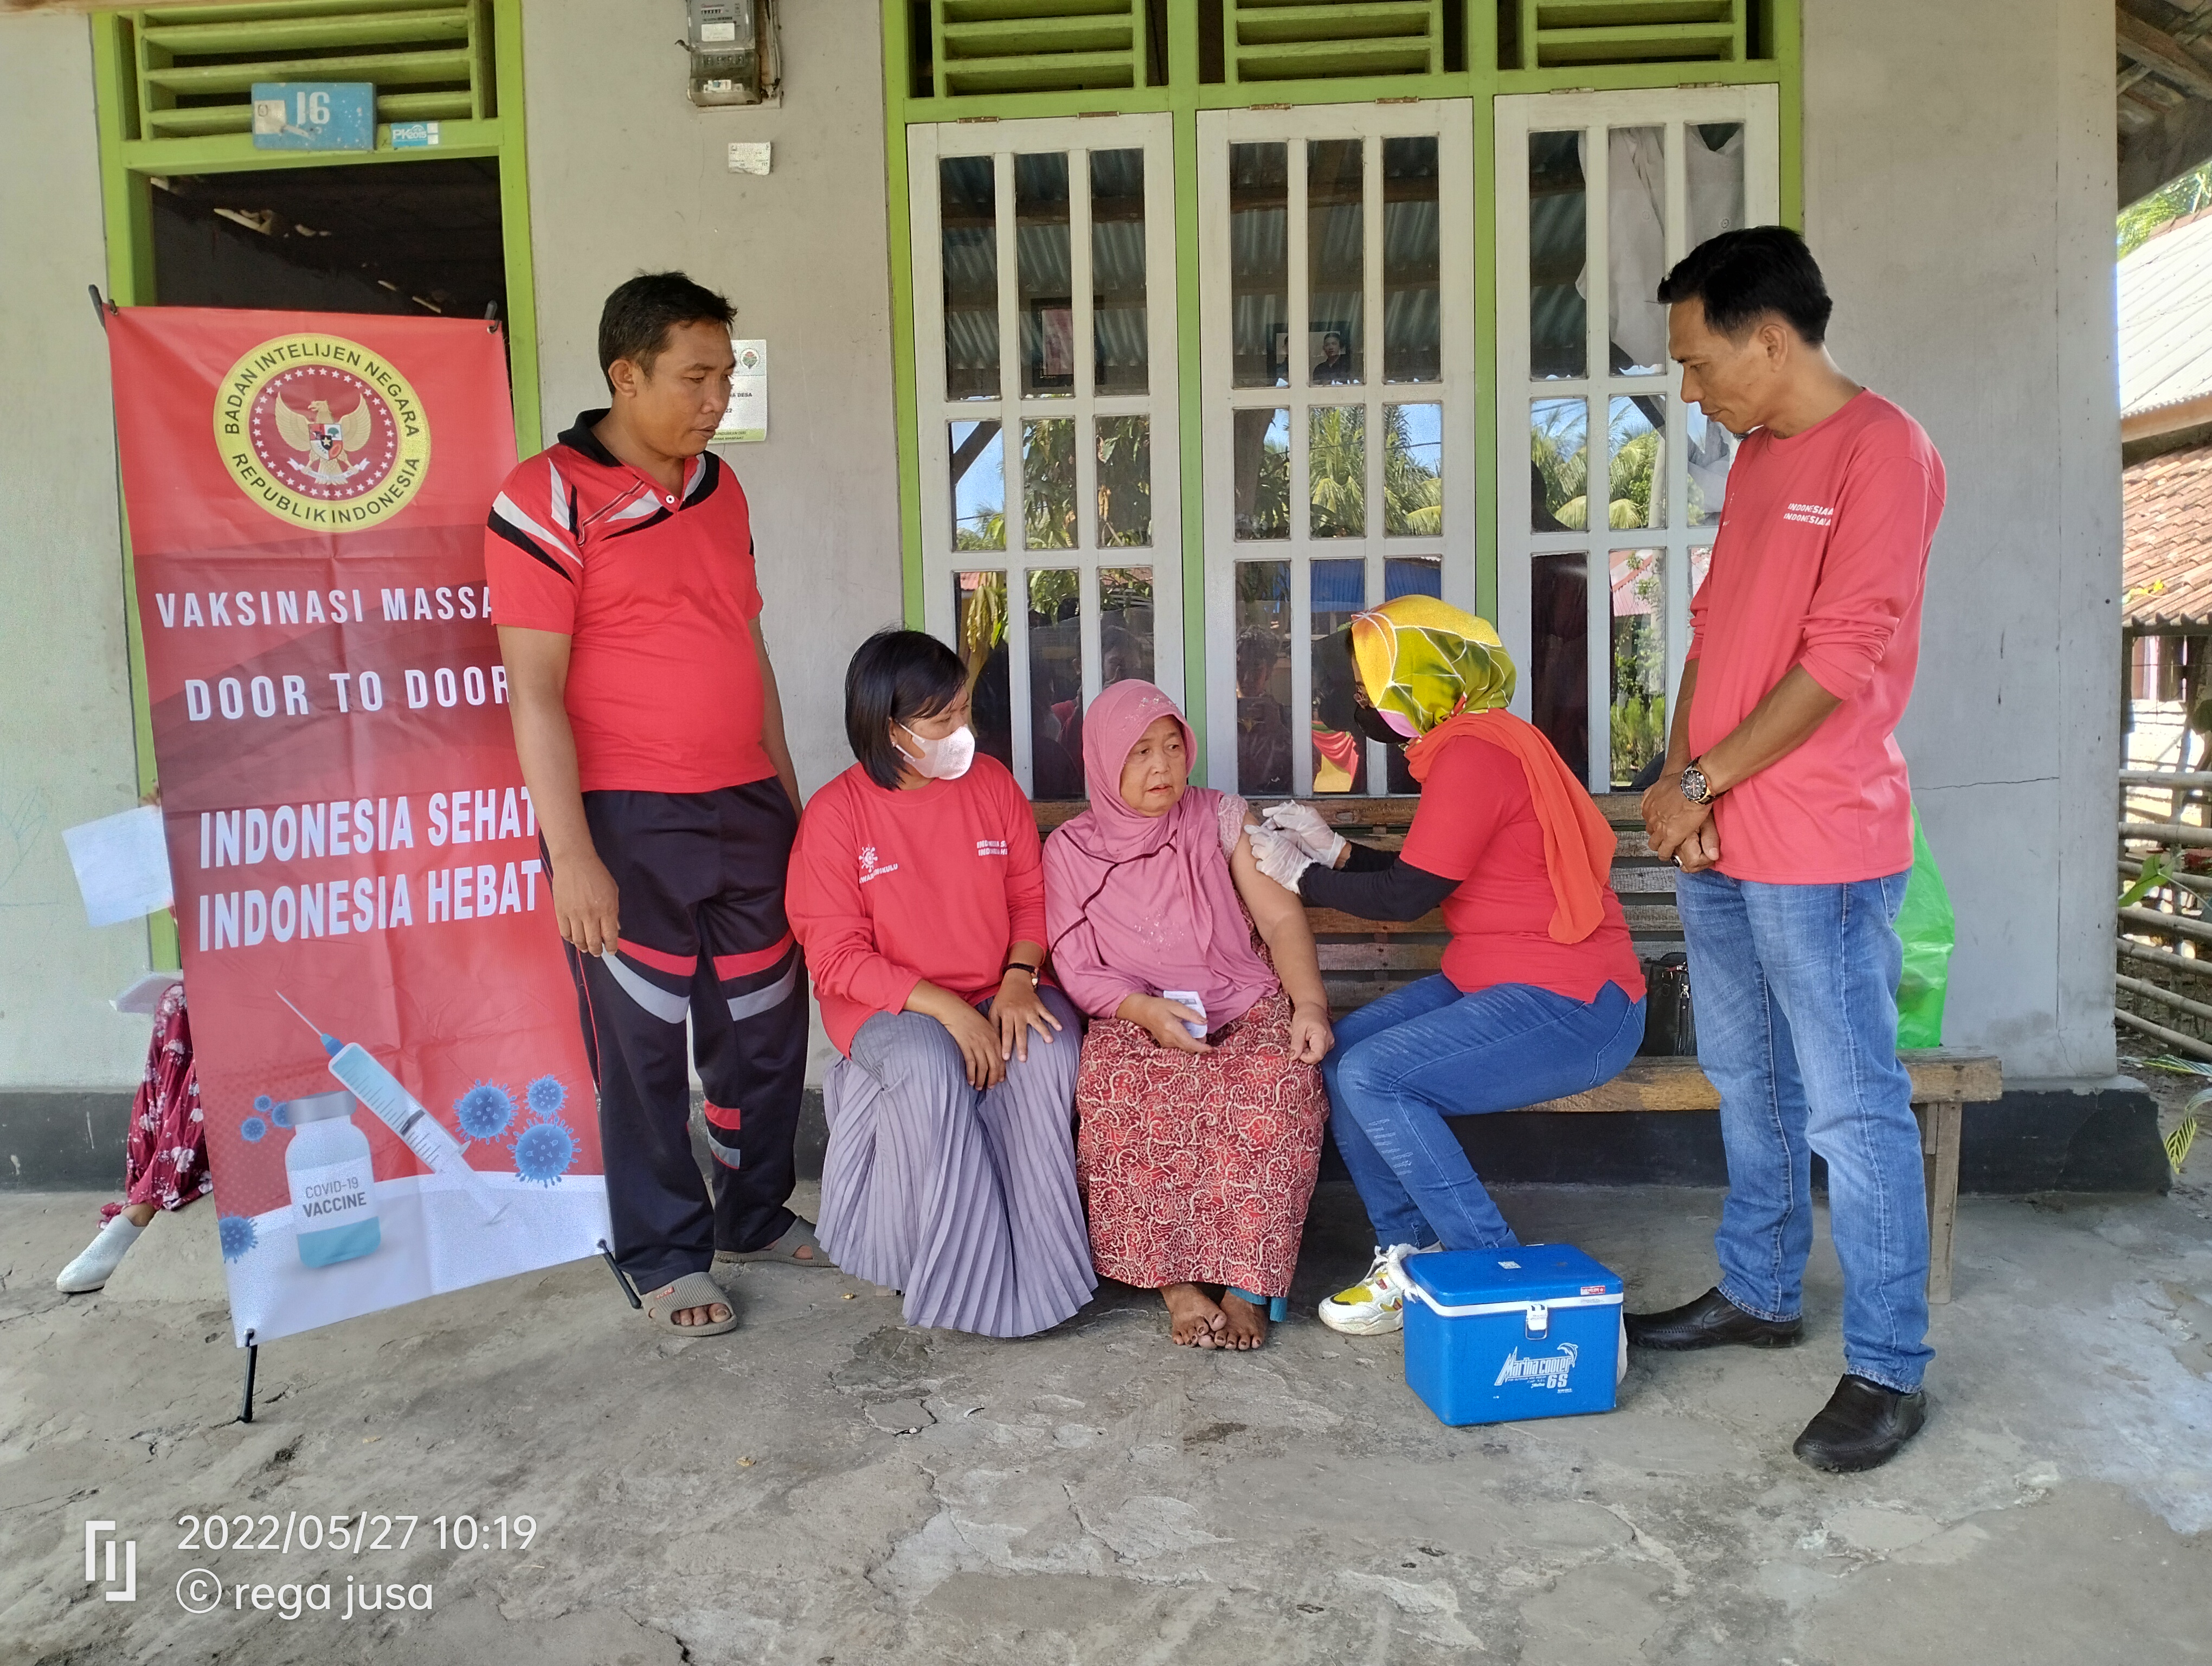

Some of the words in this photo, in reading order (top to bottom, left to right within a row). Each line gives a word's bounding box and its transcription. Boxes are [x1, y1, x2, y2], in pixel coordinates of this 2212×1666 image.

[296, 92, 330, 124] 16
[225, 368, 258, 434] BADAN
[254, 343, 361, 371] INTELIJEN
[364, 361, 420, 437] NEGARA
[232, 453, 327, 523] REPUBLIK
[332, 458, 420, 523] INDONESIA
[155, 589, 363, 628] VAKSINASI
[185, 675, 309, 721] DOOR
[329, 671, 383, 713] TO
[404, 666, 509, 709] DOOR
[200, 796, 414, 869] INDONESIA
[428, 786, 535, 846] SEHAT
[200, 874, 413, 952] INDONESIA
[428, 859, 541, 924] HEBAT
[303, 1191, 366, 1218] VACCINE
[305, 1176, 359, 1199] COVID-19
[1547, 1373, 1568, 1389] 6S
